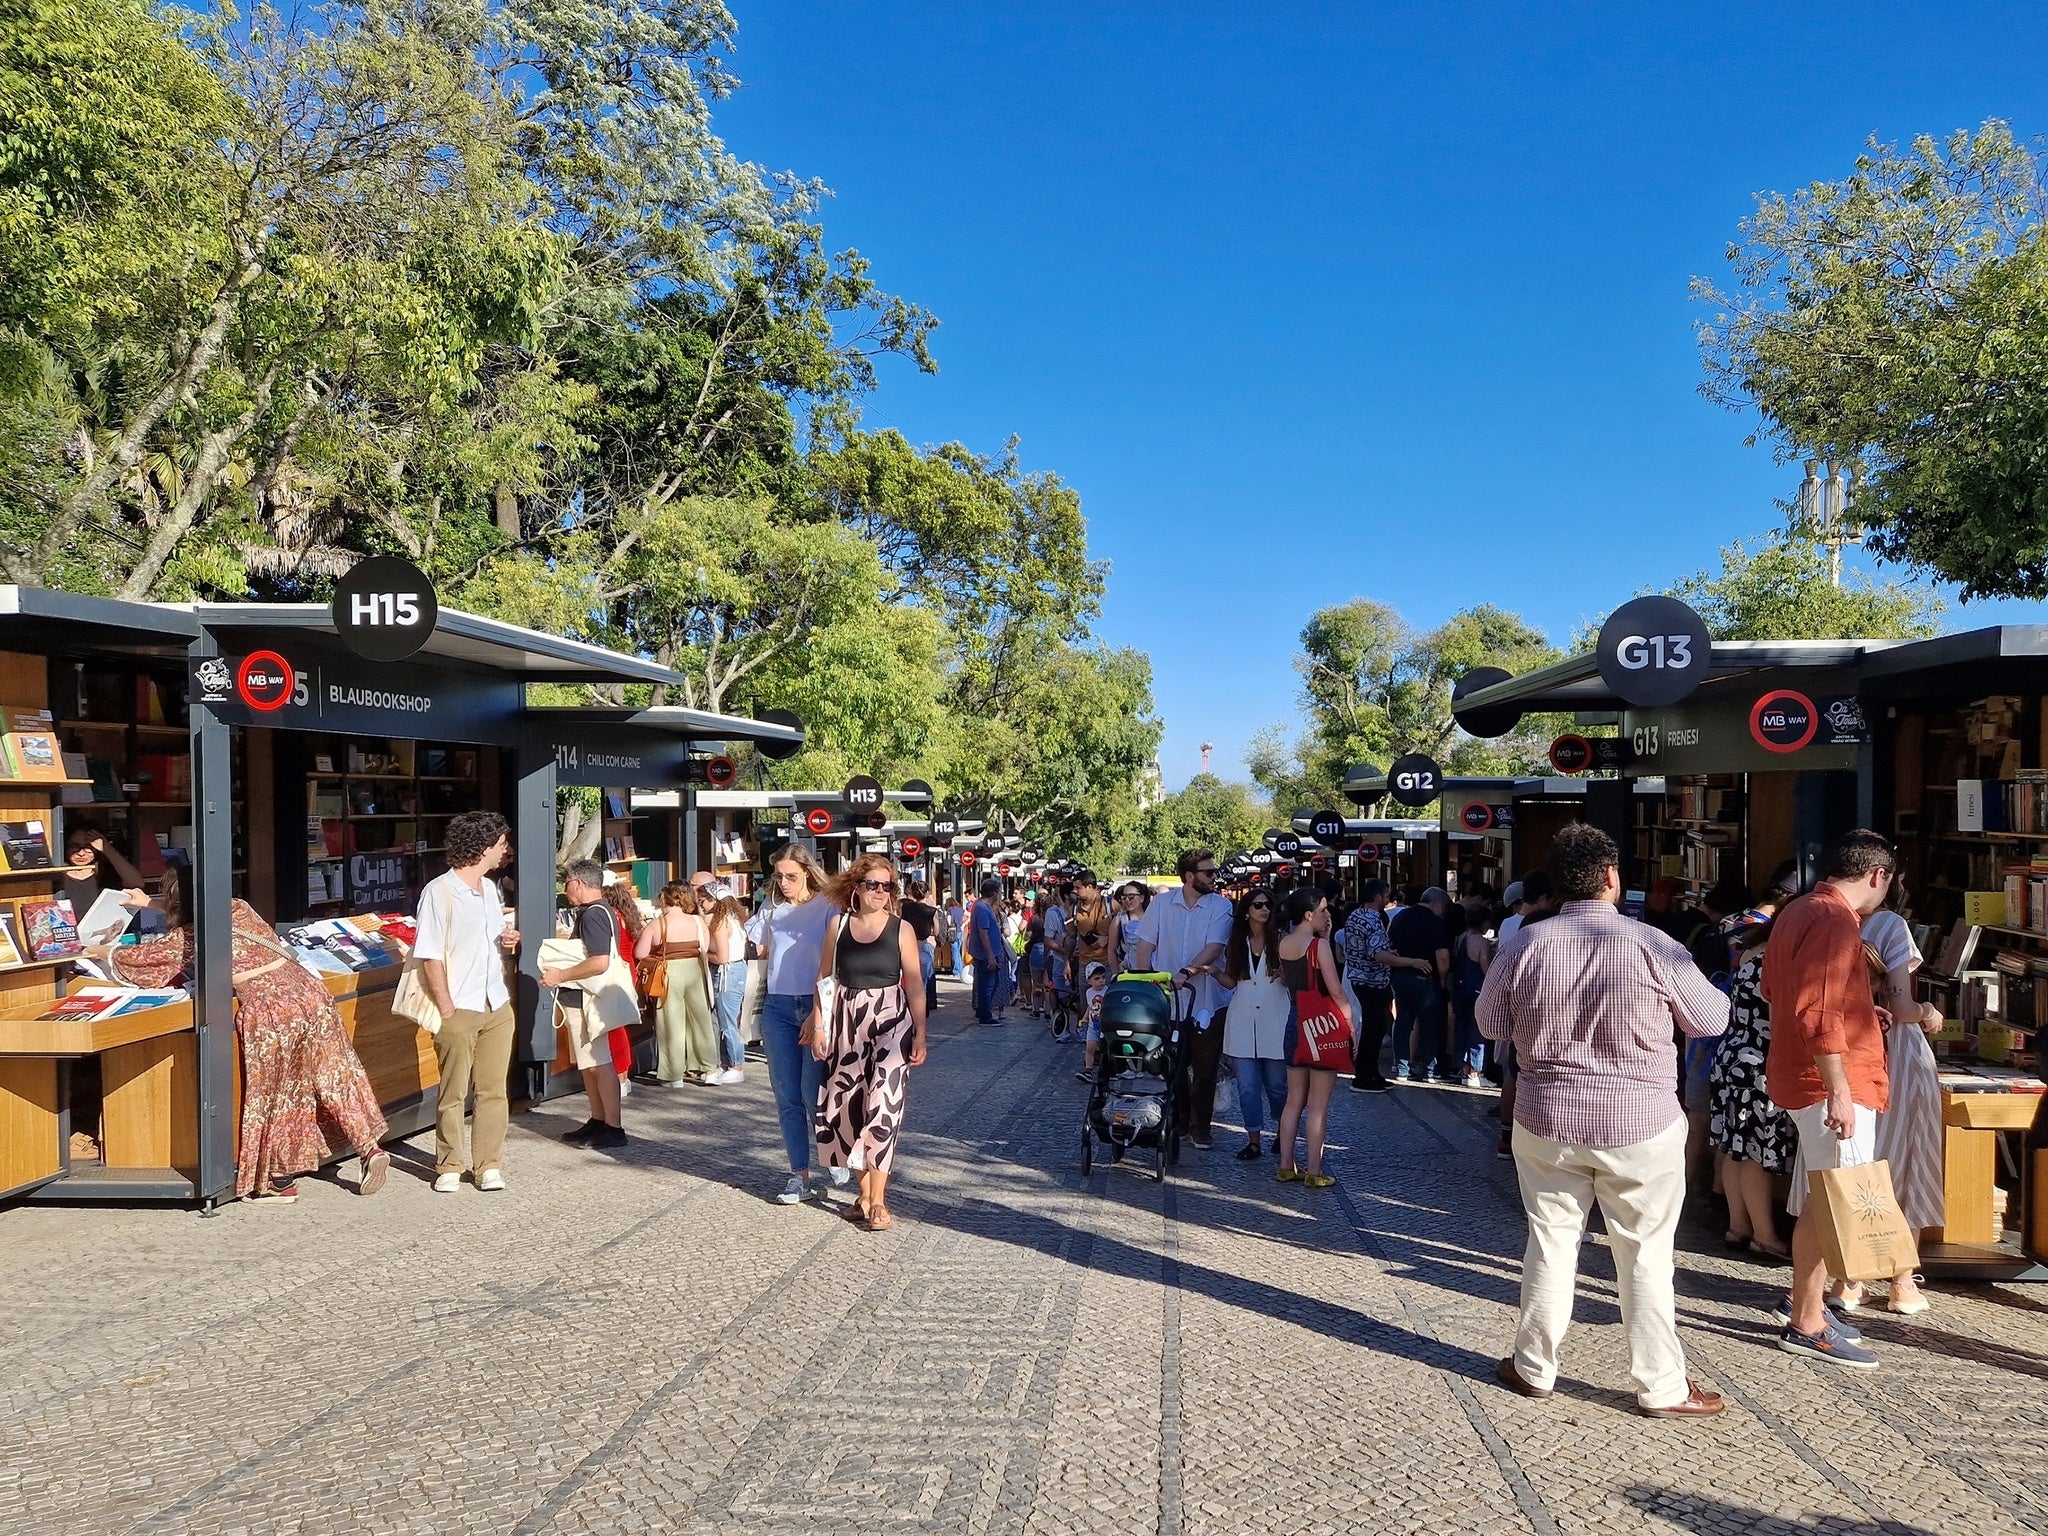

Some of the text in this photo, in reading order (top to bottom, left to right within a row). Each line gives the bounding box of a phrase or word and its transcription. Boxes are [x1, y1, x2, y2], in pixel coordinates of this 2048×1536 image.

[351, 593, 419, 626] H15
[1617, 634, 1692, 670] G13
[248, 674, 284, 686] MB WAY
[329, 684, 432, 713] BLAUBOOKSHOP
[1763, 715, 1807, 726] MB WAY
[1634, 725, 1659, 756] G13
[1667, 728, 1699, 747] FRENESI
[1556, 749, 1572, 758] MB
[587, 753, 641, 769] CHILI COM CARNE
[1396, 772, 1434, 790] G12
[849, 788, 877, 803] H13
[934, 822, 954, 833] H12
[1316, 823, 1339, 835] G11
[987, 838, 1001, 848] H11
[1278, 841, 1297, 851] G10
[1021, 851, 1036, 860] H10
